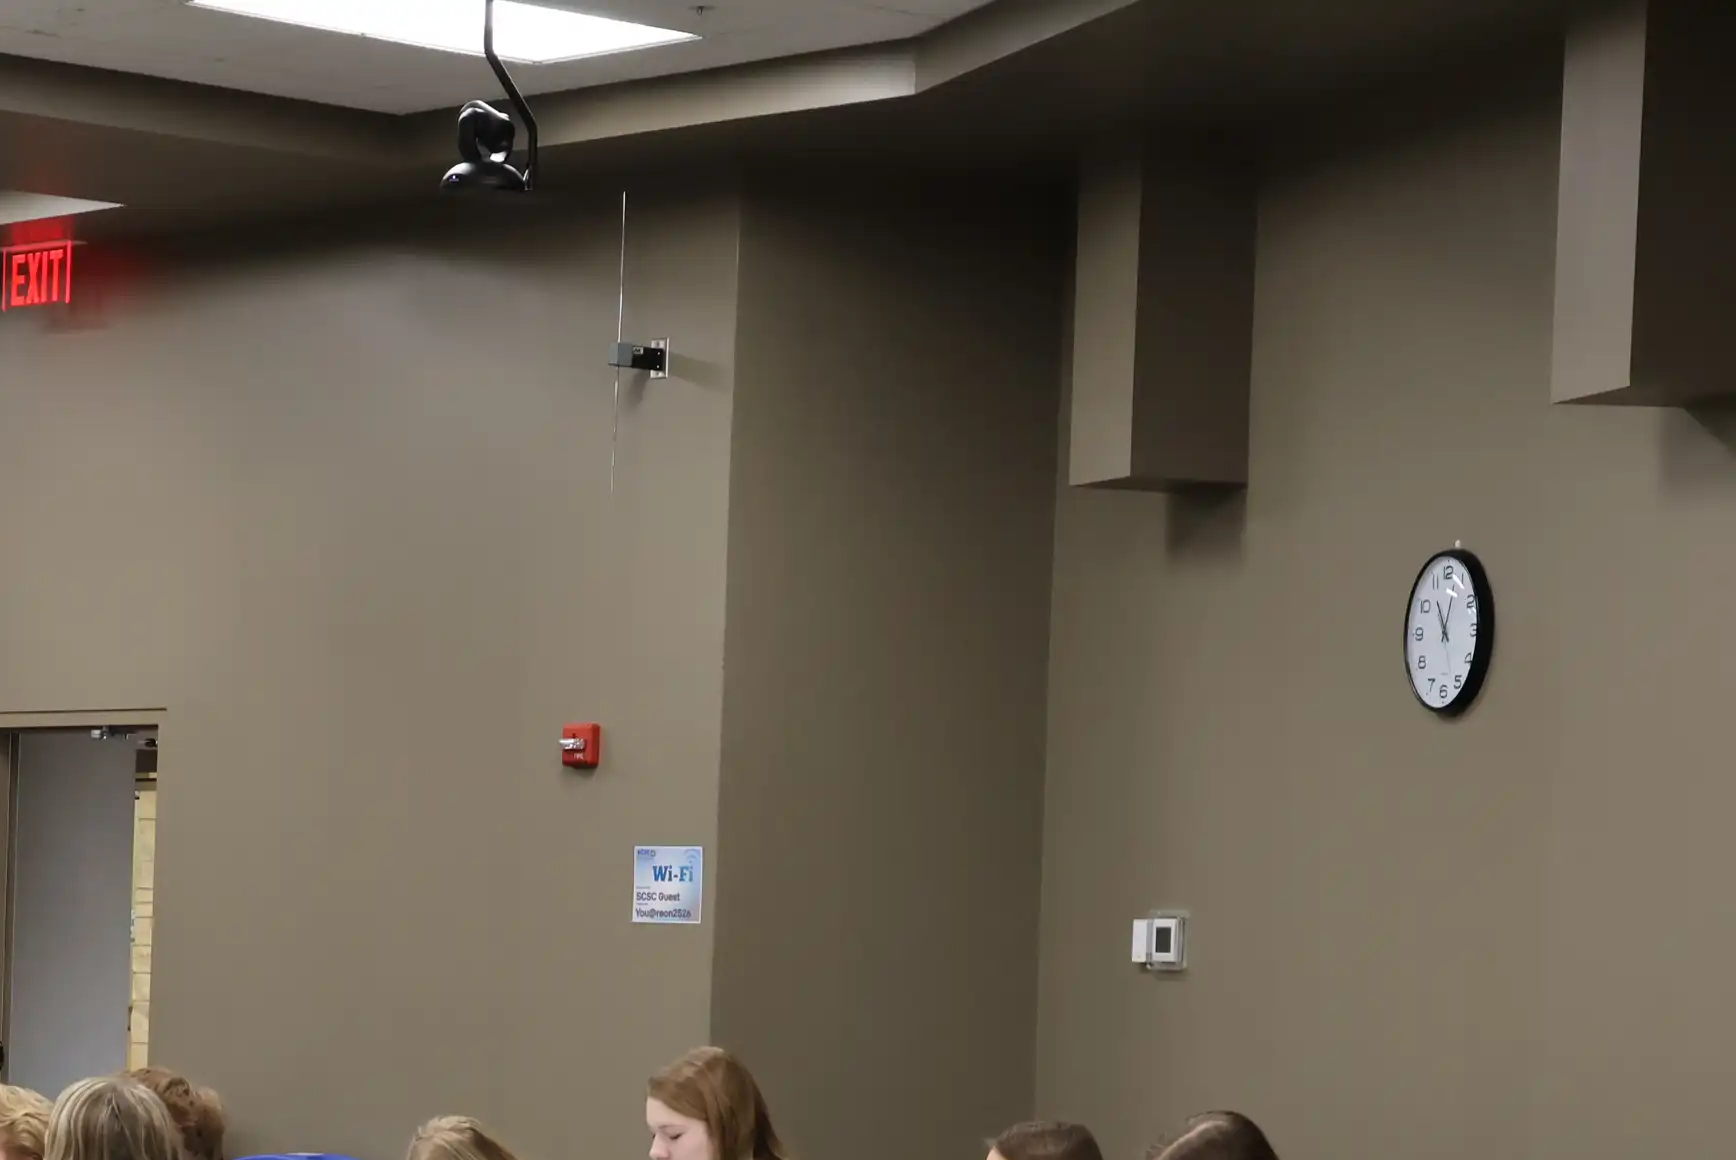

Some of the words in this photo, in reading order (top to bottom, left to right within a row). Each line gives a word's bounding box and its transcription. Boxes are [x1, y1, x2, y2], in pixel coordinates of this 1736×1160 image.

[11, 249, 64, 306] EXIT
[1443, 565, 1454, 579] 12
[1432, 573, 1439, 590] 11
[1420, 599, 1431, 614] 10
[1414, 627, 1424, 641] 9
[1470, 623, 1478, 637] 3
[1418, 655, 1427, 669] 8
[1427, 678, 1436, 692] 7
[1453, 675, 1462, 689] 5
[1439, 685, 1448, 699] 6
[652, 864, 694, 882] Wi-Fi
[636, 892, 657, 901] SCSC
[658, 892, 680, 901] Guest
